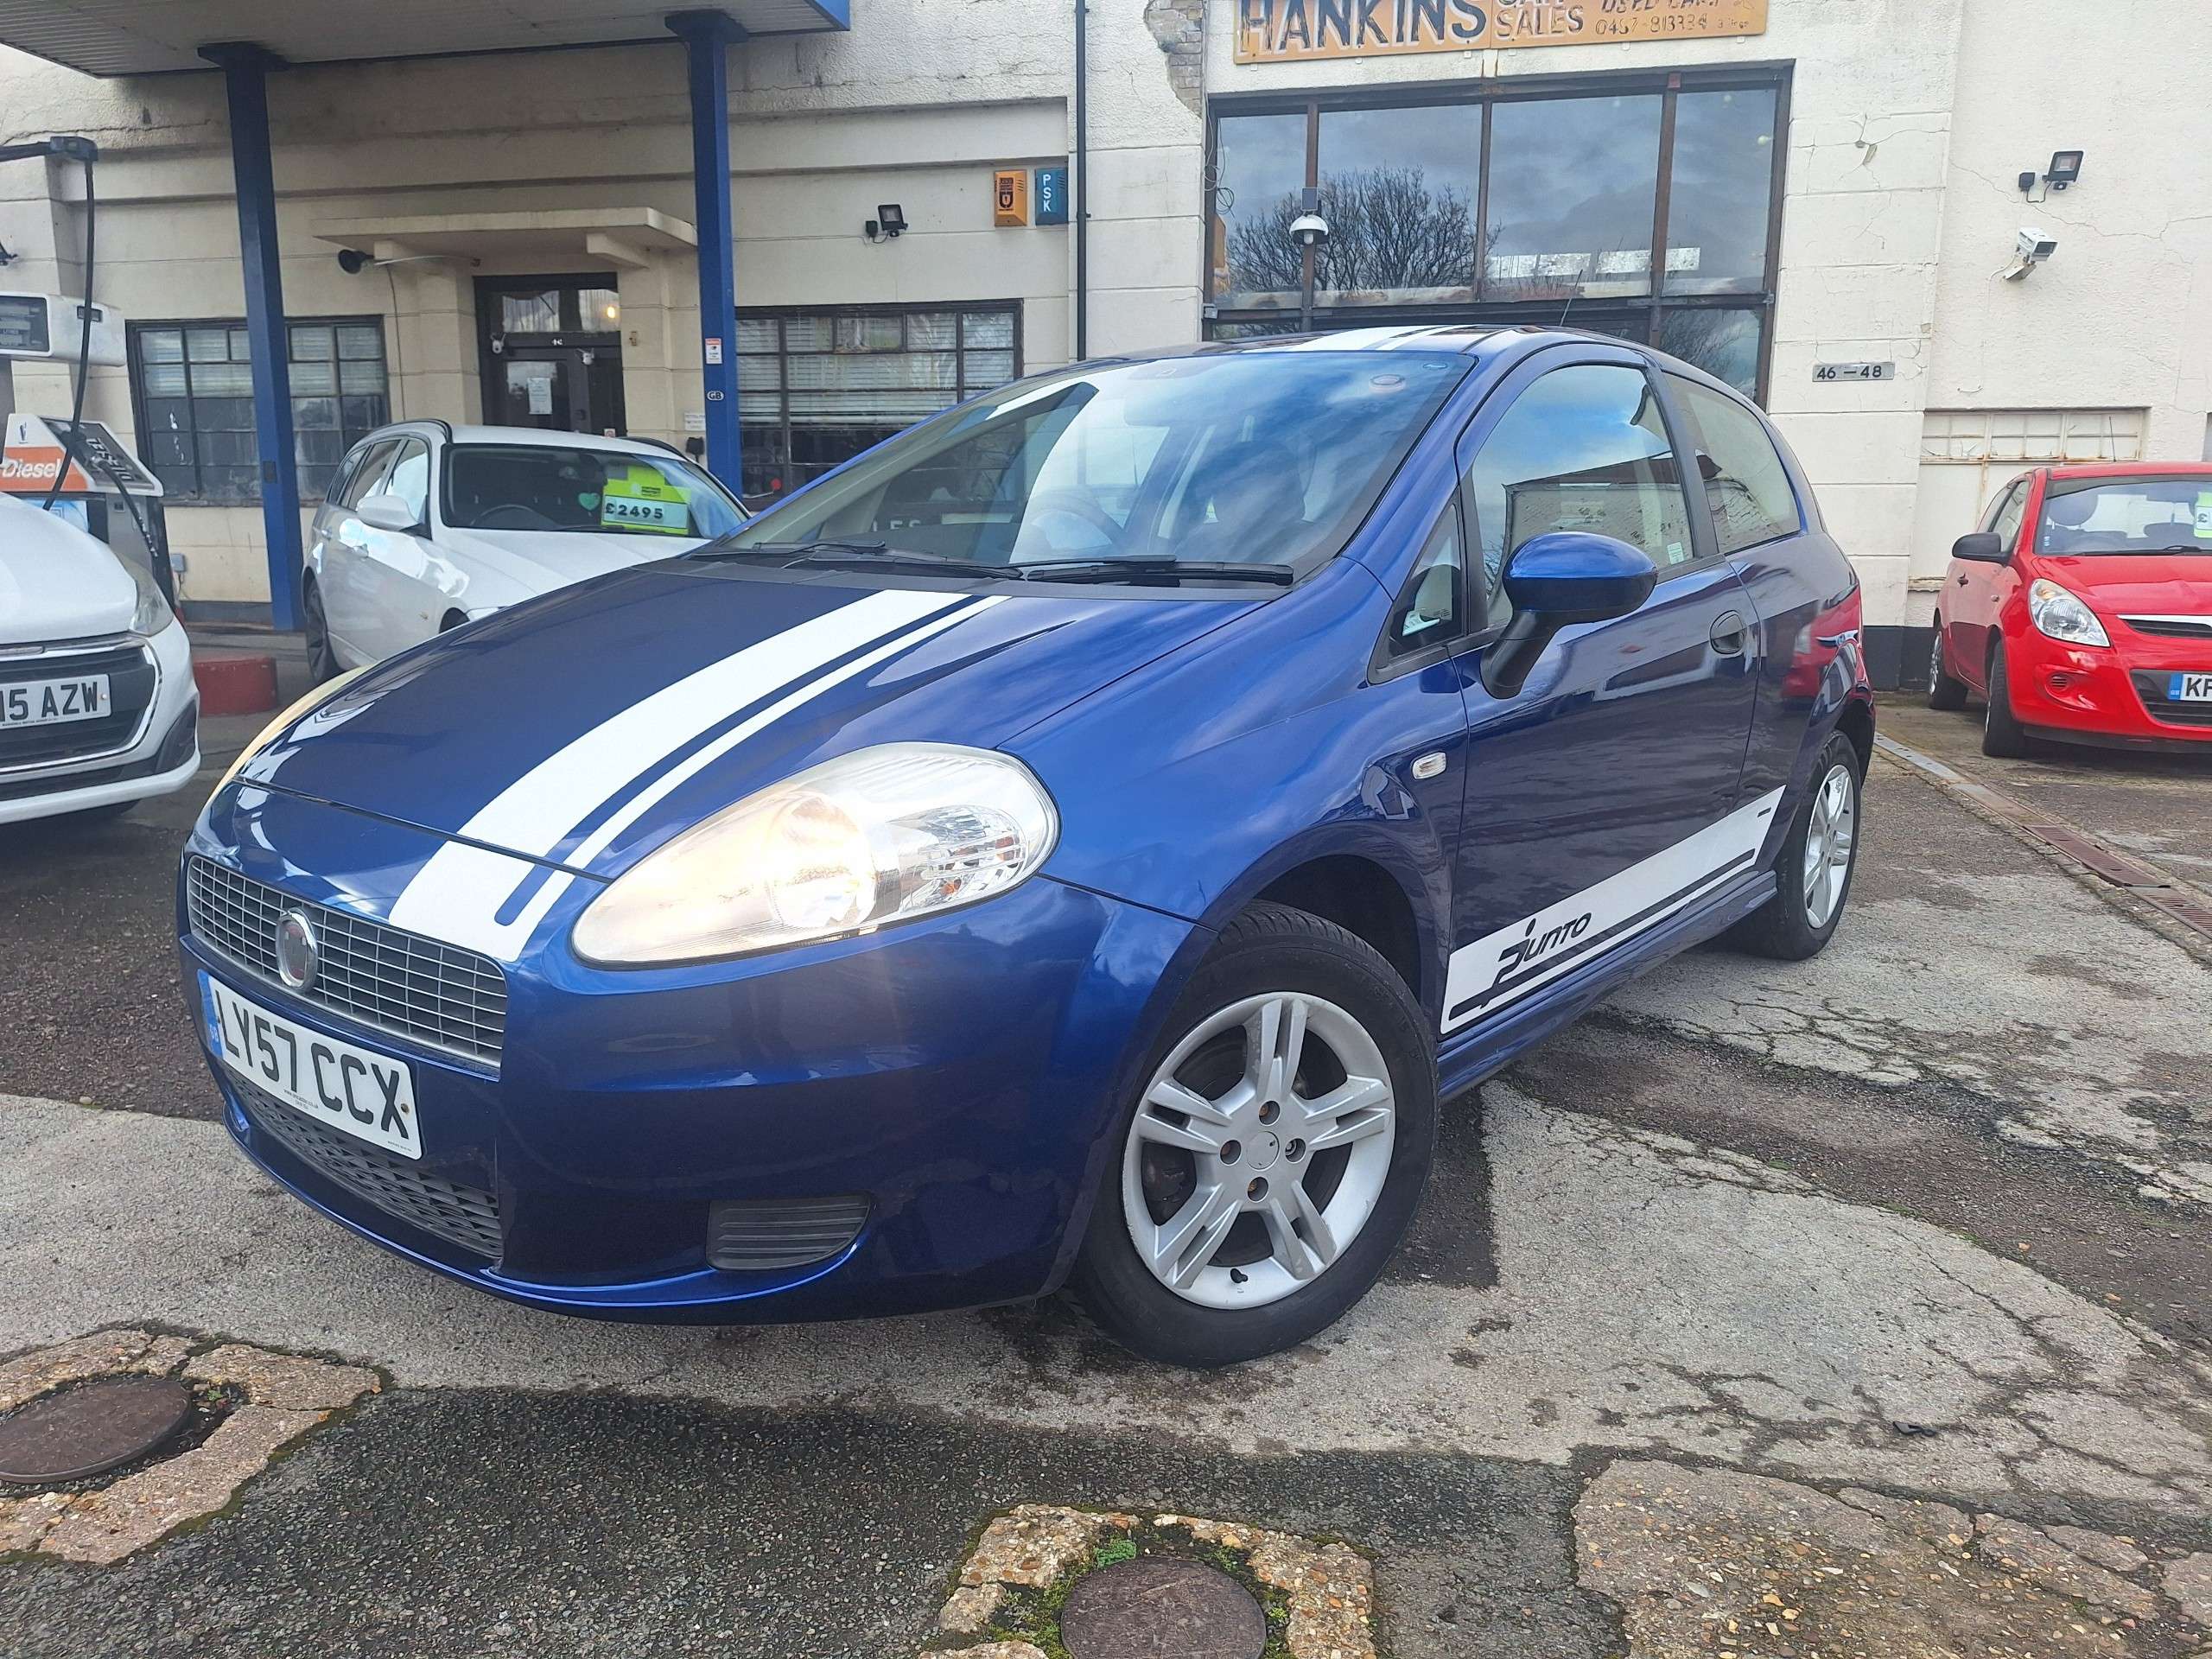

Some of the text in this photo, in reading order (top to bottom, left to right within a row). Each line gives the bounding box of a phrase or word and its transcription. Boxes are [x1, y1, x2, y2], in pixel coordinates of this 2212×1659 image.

[1238, 0, 1486, 53] HANKINS
[1496, 4, 1584, 37] SALES
[1042, 174, 1052, 212] PSK
[1817, 366, 1836, 379] 46
[1860, 365, 1882, 378] 48
[2, 458, 61, 479] Diesel
[605, 503, 664, 519] £2495
[41, 681, 98, 718] AZW
[214, 989, 409, 1140] LY57 CCX
